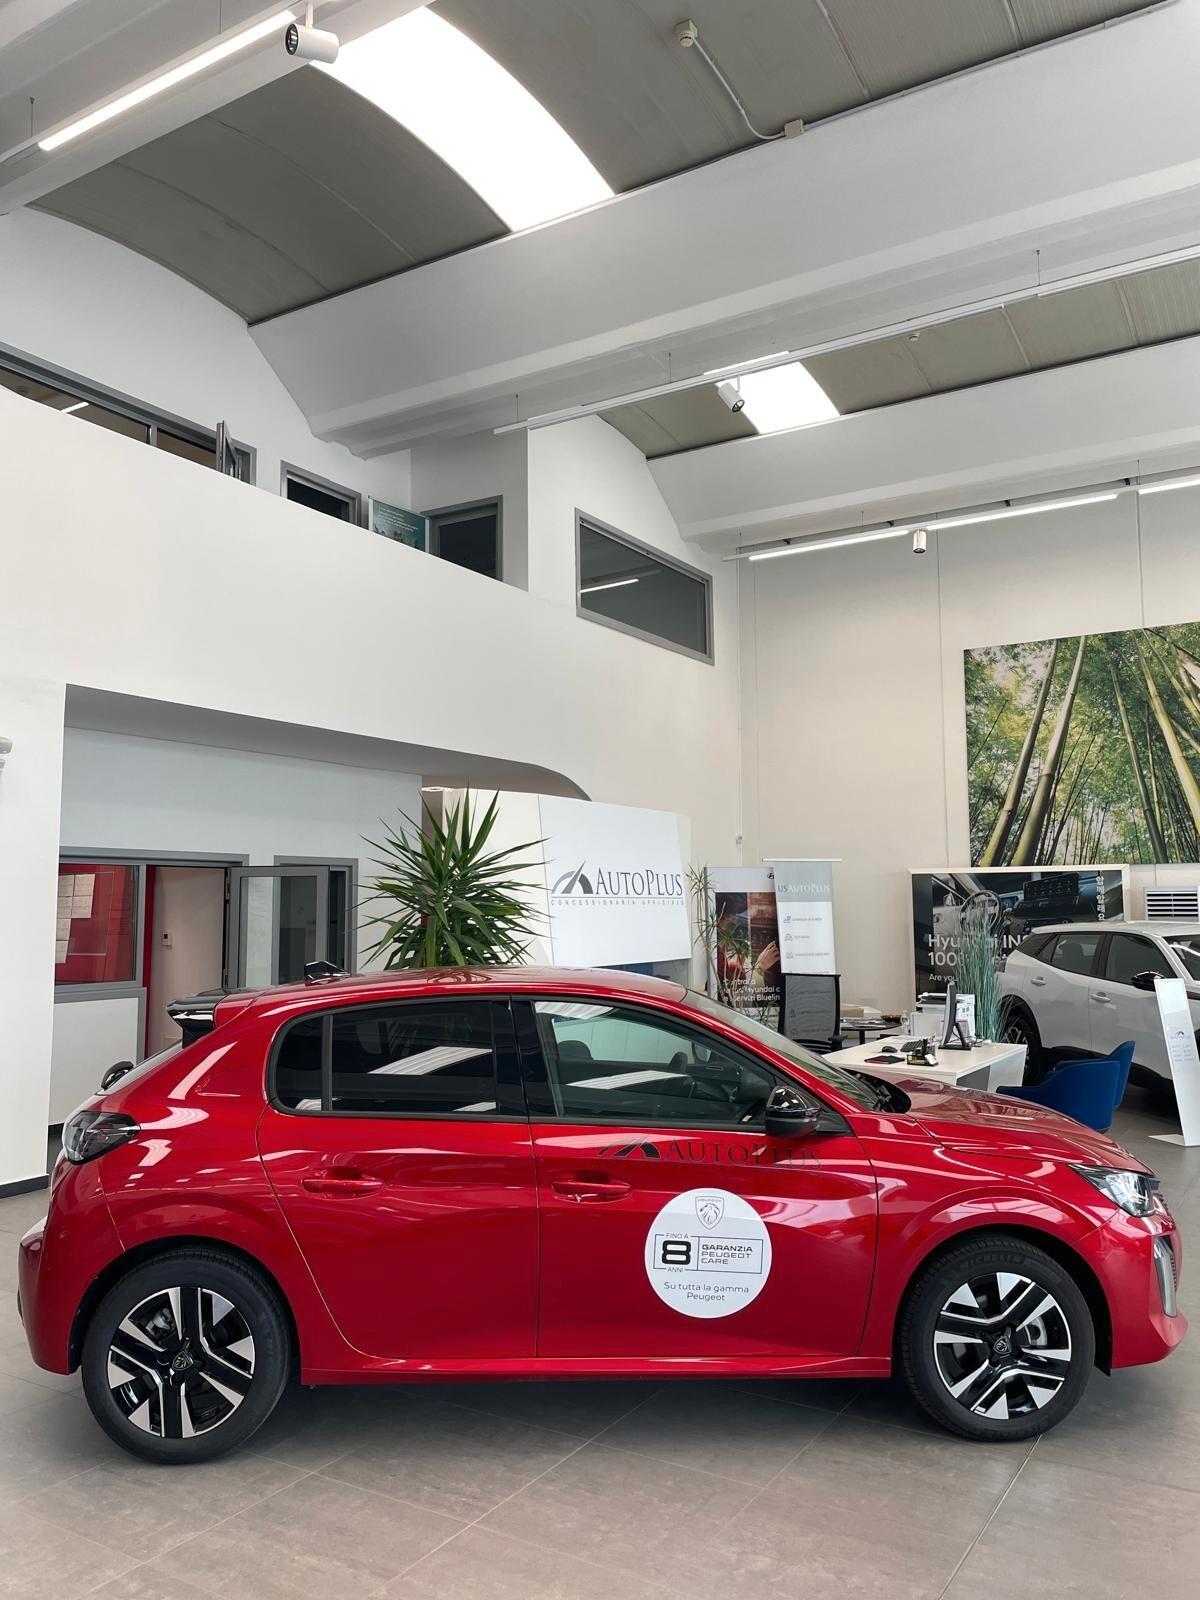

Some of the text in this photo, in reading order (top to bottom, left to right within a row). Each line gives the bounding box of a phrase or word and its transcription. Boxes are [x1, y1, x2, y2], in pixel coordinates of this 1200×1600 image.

[929, 973, 943, 981] Are
[701, 1244, 753, 1252] GARANZIA
[661, 1240, 692, 1266] 8
[664, 1282, 676, 1290] Su
[678, 1283, 701, 1291] tutta
[703, 1283, 711, 1291] la
[687, 1291, 725, 1302] Peugeot
